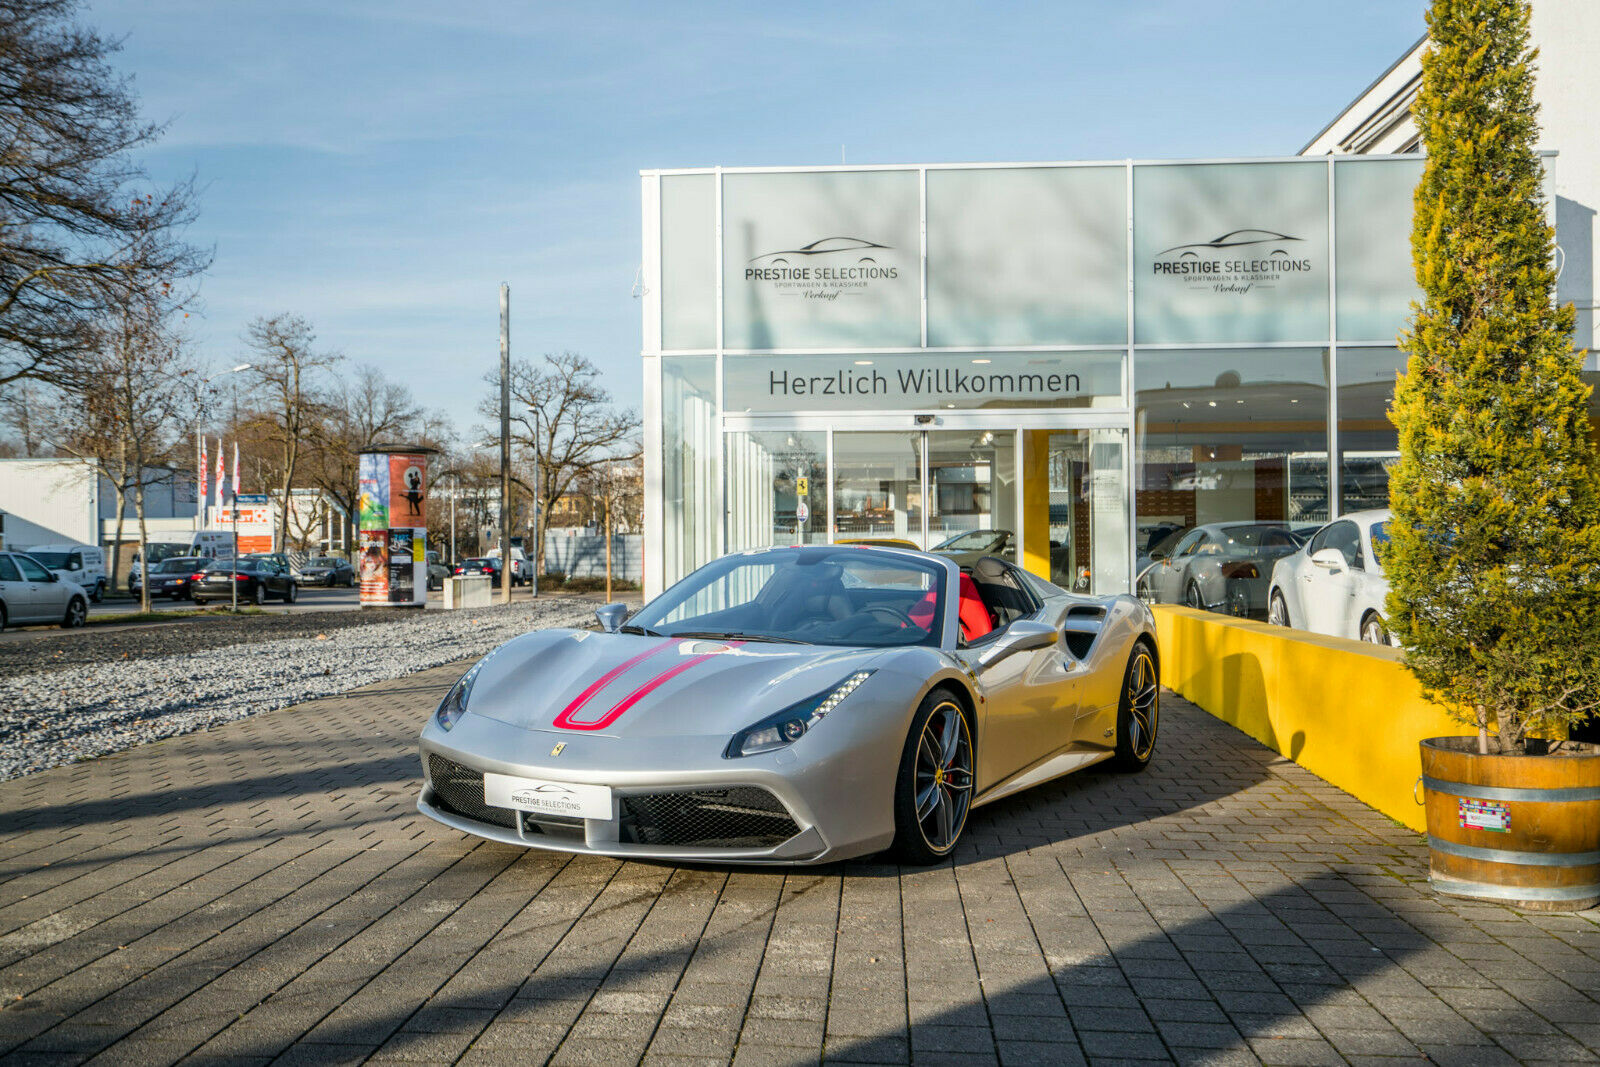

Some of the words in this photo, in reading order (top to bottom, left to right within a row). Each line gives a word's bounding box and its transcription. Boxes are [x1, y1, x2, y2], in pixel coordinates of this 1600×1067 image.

[745, 268, 810, 280] PRESTIGE
[814, 267, 898, 279] SELECTIONS
[1153, 262, 1220, 274] PRESTIGE
[1225, 260, 1311, 273] SELECTIONS
[769, 370, 887, 395] Herzlich
[897, 368, 1081, 394] Willkommen
[511, 795, 541, 806] PRESTIGE
[541, 800, 581, 810] SELECTIONS
